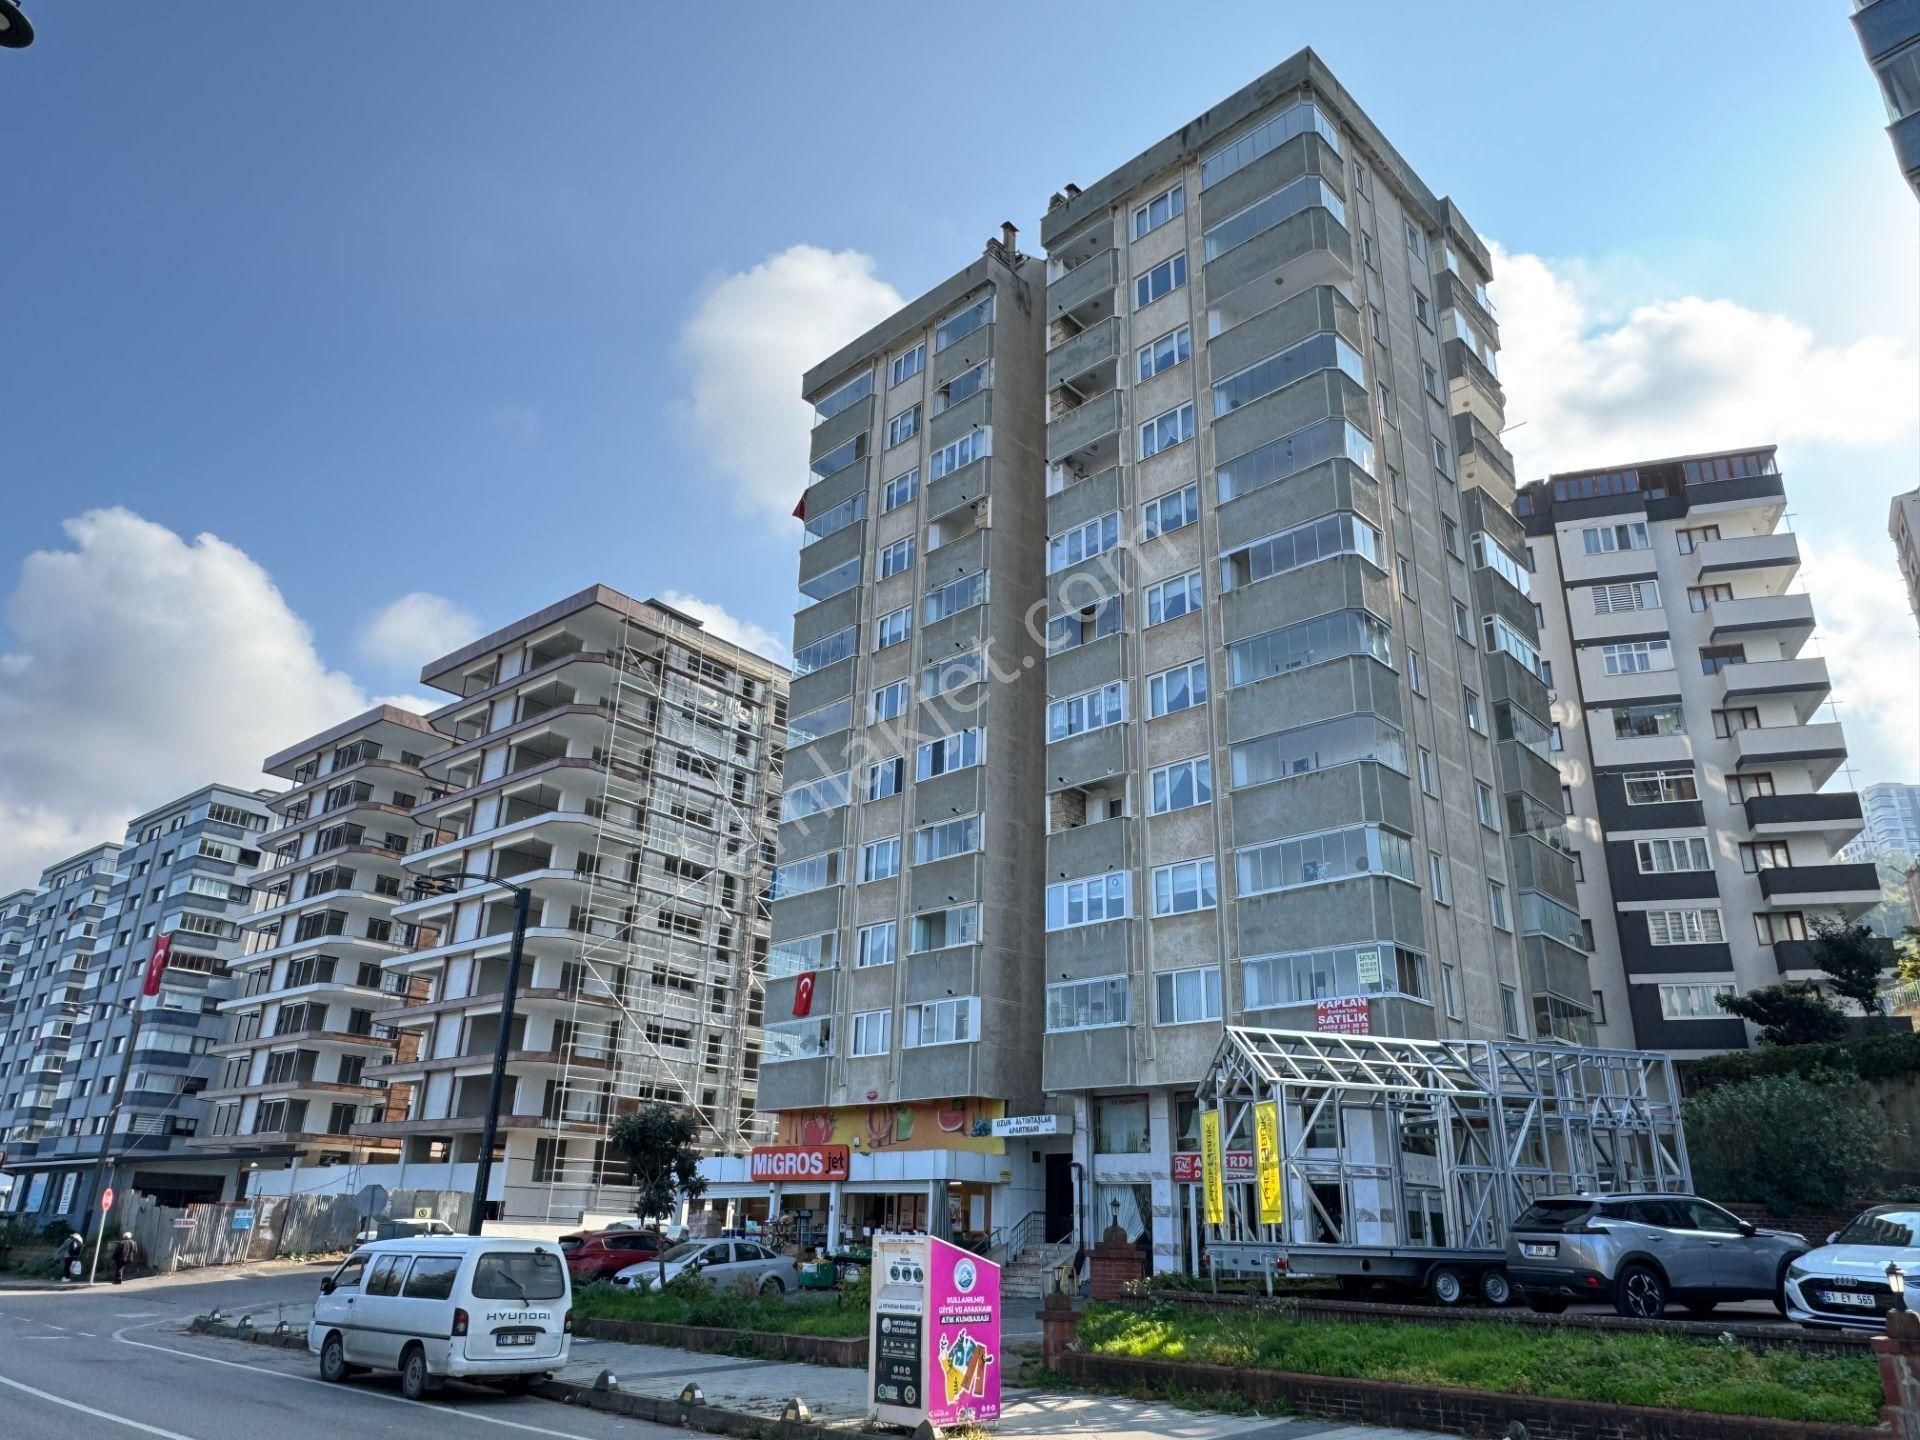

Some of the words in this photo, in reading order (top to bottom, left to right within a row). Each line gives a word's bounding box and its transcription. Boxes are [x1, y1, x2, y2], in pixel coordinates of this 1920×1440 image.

[1317, 997, 1367, 1009] KAPLAN
[1318, 1013, 1368, 1024] SATILIK
[825, 1152, 844, 1174] jet
